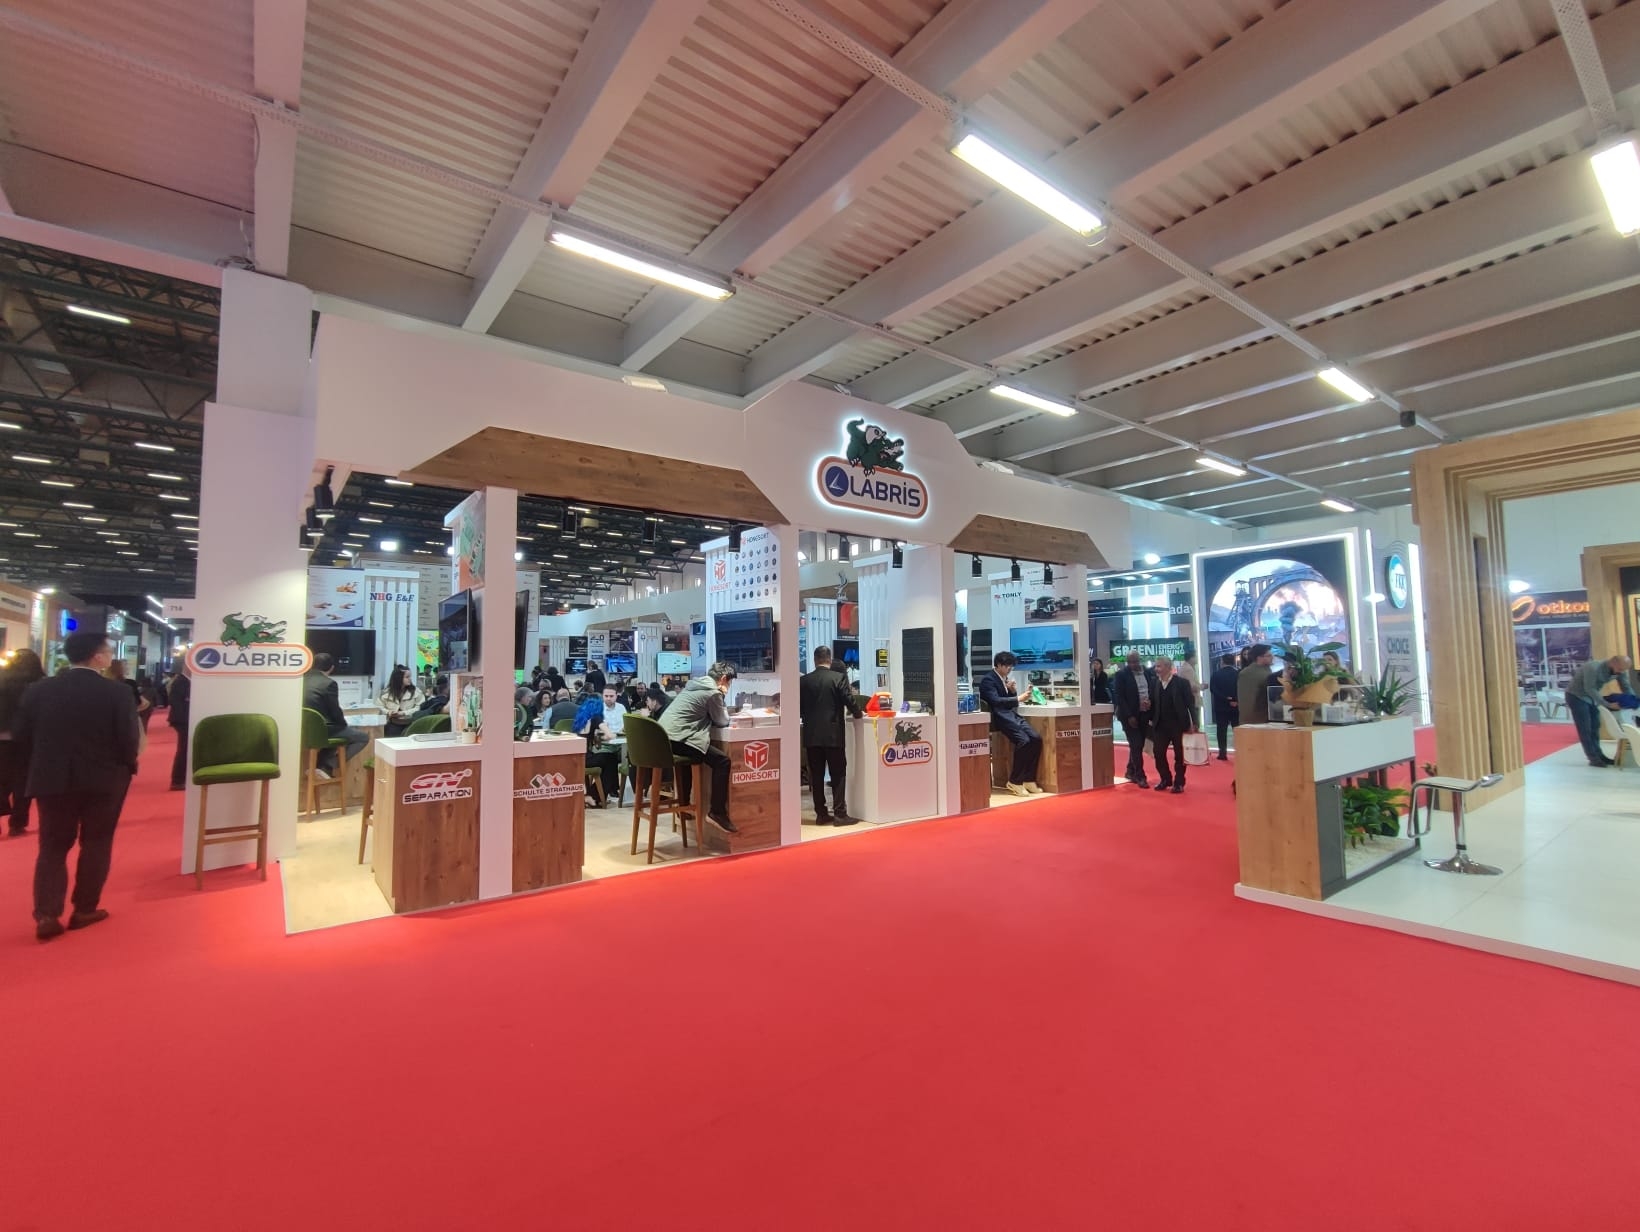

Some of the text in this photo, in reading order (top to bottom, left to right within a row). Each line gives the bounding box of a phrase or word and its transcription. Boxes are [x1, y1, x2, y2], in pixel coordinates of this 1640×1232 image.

[369, 592, 415, 602] NHG E&E
[1112, 644, 1155, 657] GREEN
[1158, 642, 1185, 650] ENERGY
[733, 770, 778, 782] HONESORT
[404, 788, 471, 803] SEPARATION
[513, 788, 544, 797] SCHULTE
[545, 784, 584, 794] STRATHAUS
